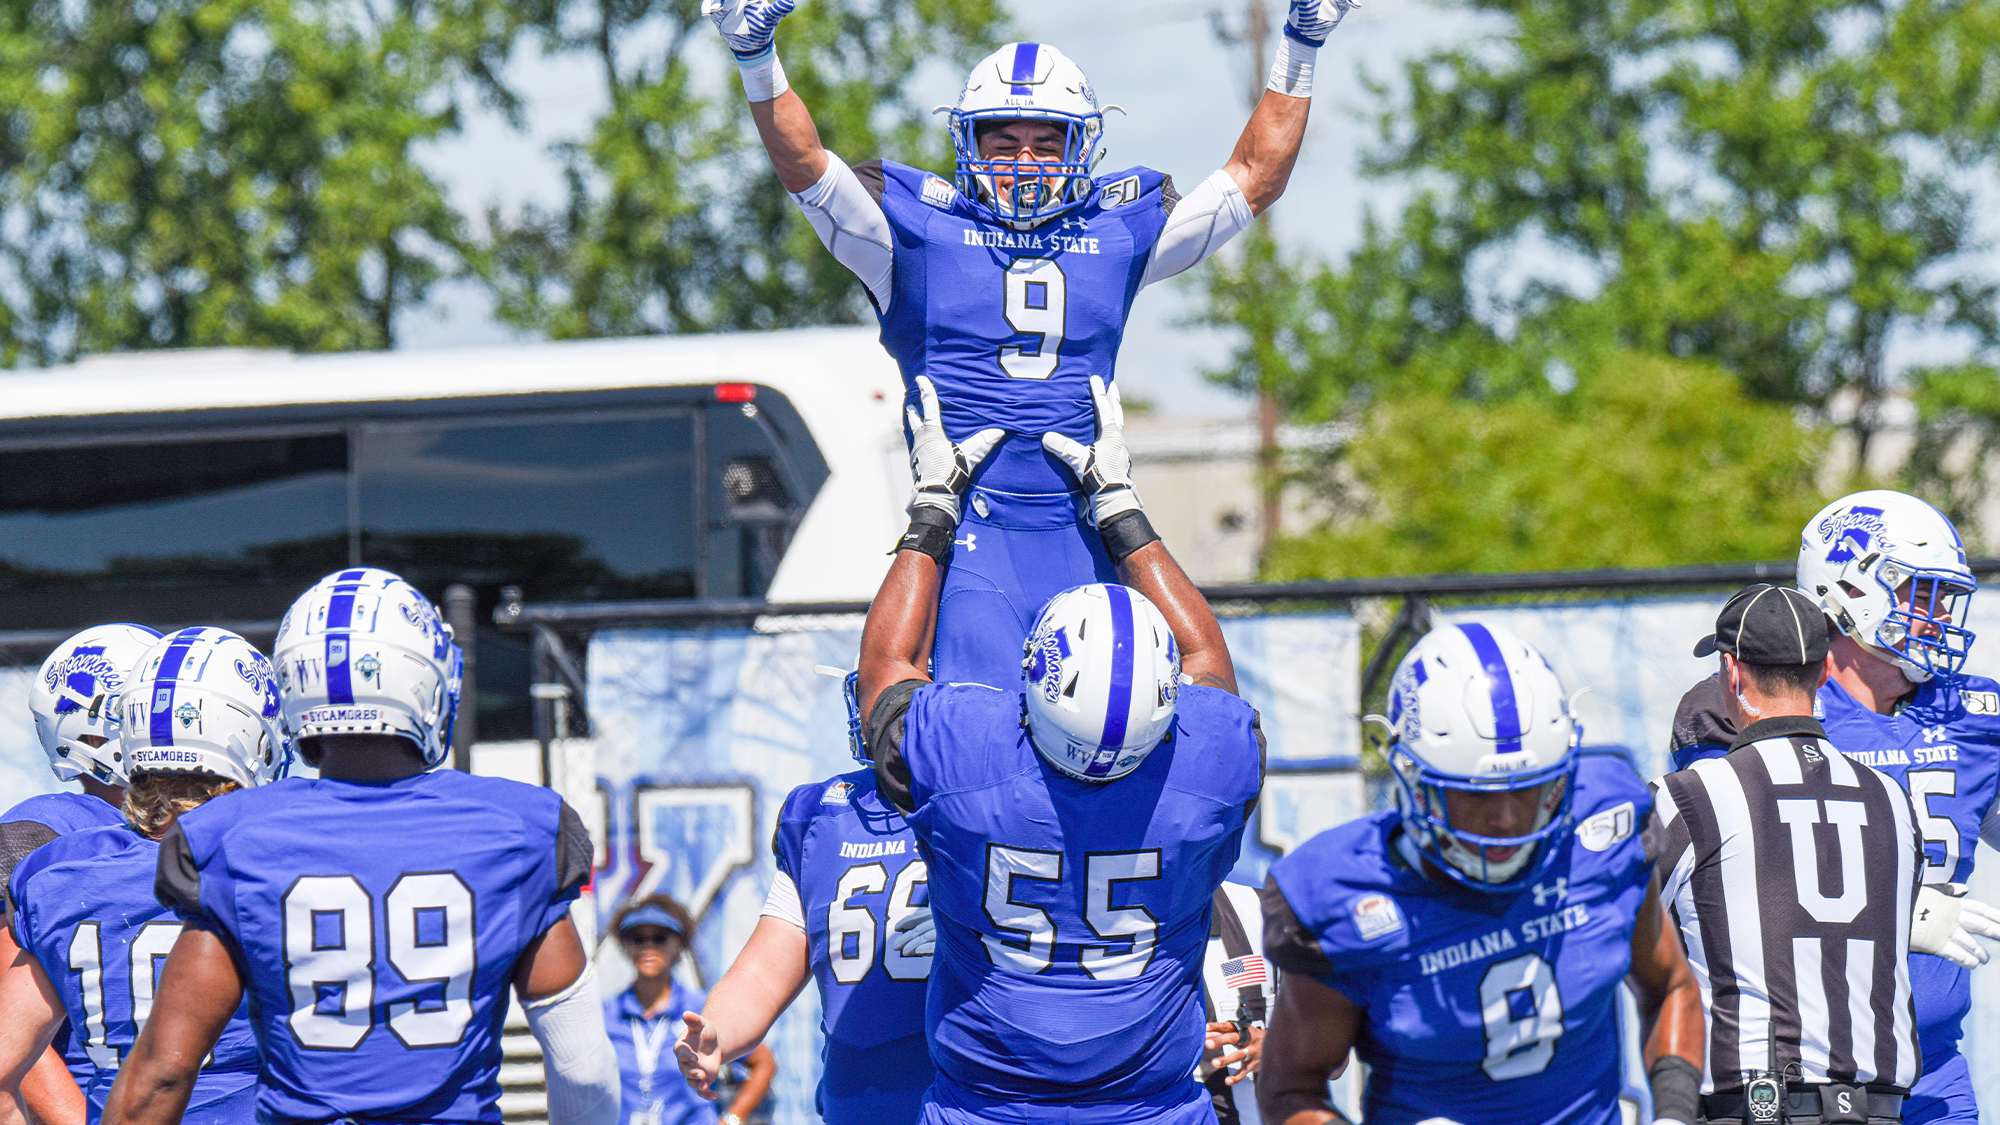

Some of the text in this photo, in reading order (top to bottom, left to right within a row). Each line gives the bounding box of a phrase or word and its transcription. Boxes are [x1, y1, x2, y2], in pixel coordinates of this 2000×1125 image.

[963, 229, 1100, 255] INDIANA STATE
[997, 254, 1067, 380] 9
[1818, 512, 1899, 553] Sycamores
[331, 645, 342, 654] 89
[45, 653, 125, 693] Sycamores
[158, 693, 167, 702] 10
[309, 709, 378, 723] SYCAMORES
[136, 751, 198, 763] SYCAMORES
[1066, 743, 1092, 765] WV
[1913, 744, 1959, 765] STATE
[839, 840, 906, 859] INDIANA
[1778, 798, 1869, 924] U
[982, 841, 1162, 980] 55
[1418, 903, 1590, 976] INDIANA STATE
[281, 869, 477, 1051] 89
[1476, 952, 1566, 1082] 8
[1837, 1091, 1853, 1114] S
